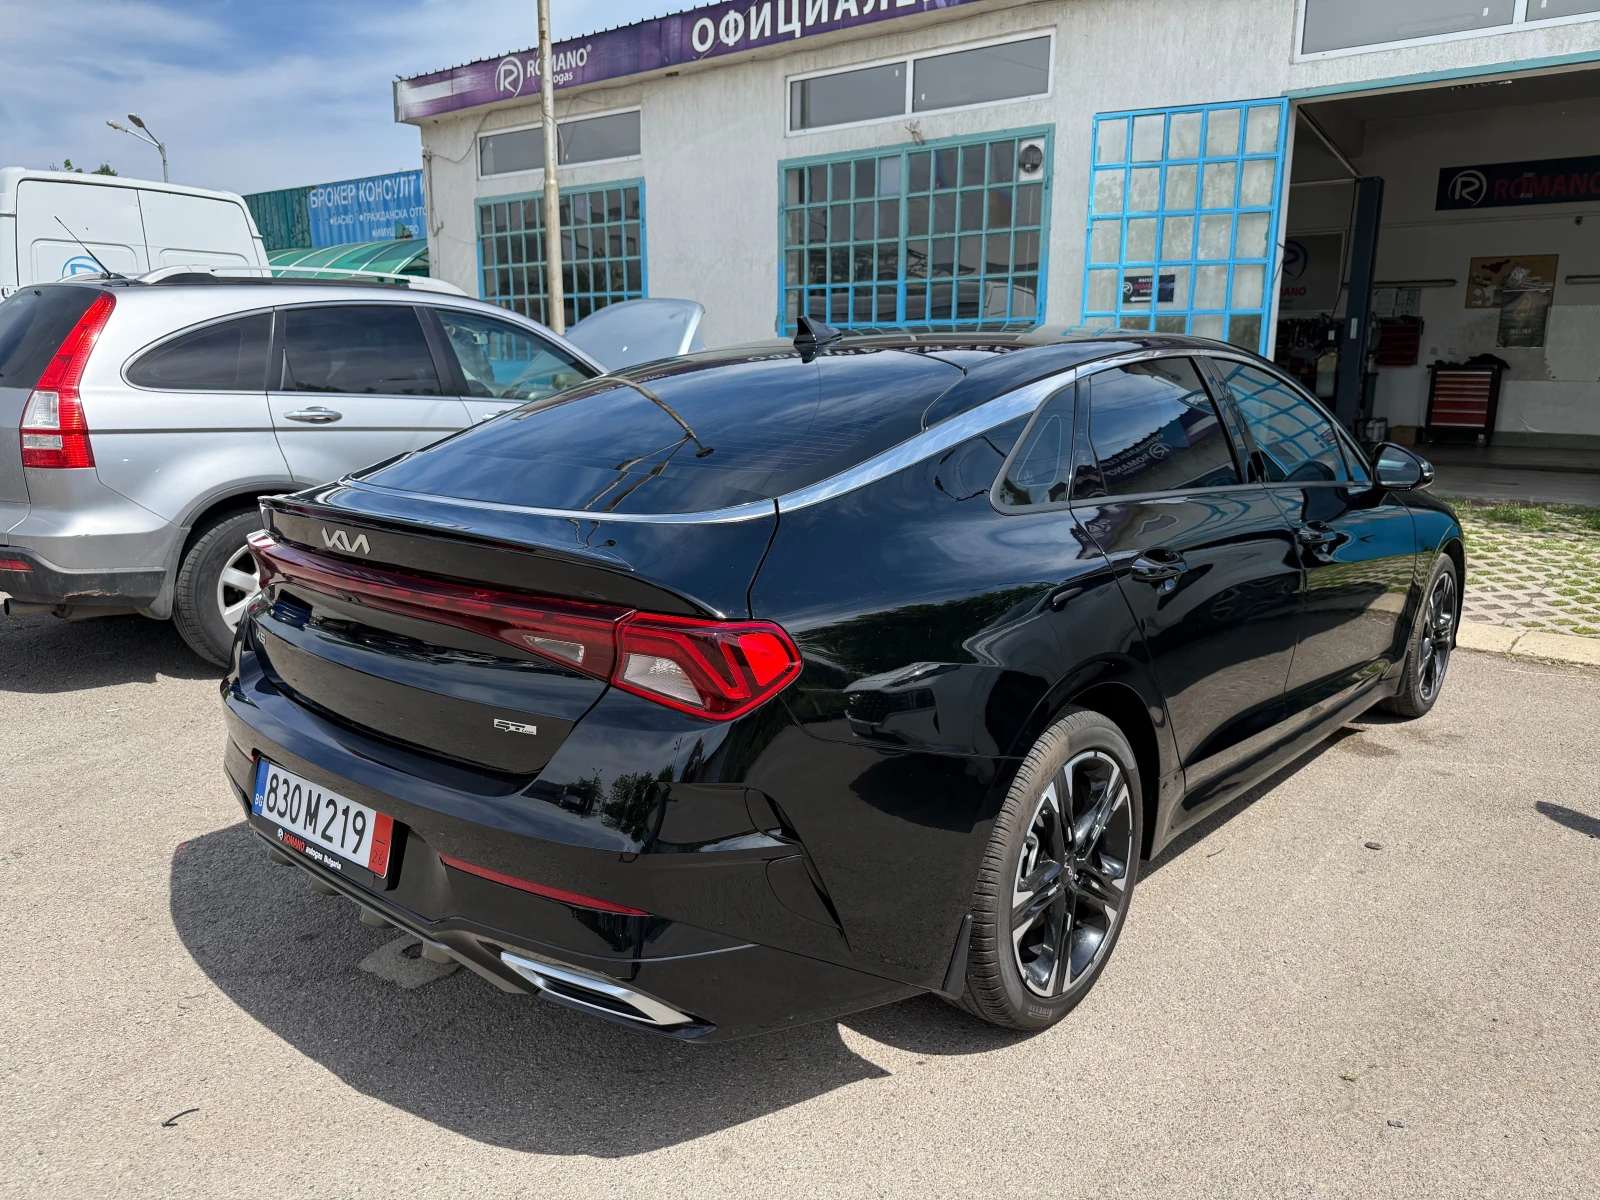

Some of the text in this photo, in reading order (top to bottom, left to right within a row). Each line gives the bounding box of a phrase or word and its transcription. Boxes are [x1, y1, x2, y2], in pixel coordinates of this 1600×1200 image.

[691, 0, 931, 52] ОФИЦИА
[551, 71, 573, 85] ogas
[310, 184, 355, 208] БРОКЕР
[359, 175, 416, 203] КОНСУЛТ
[363, 209, 407, 222] ГРАЖДАНСКА
[376, 224, 419, 237] ИМУВО
[321, 526, 371, 556] KIA
[254, 773, 367, 855] BG 830M219
[283, 832, 306, 852] ROMANO
[305, 846, 323, 861] autogas
[323, 855, 342, 870] Bulgaria
